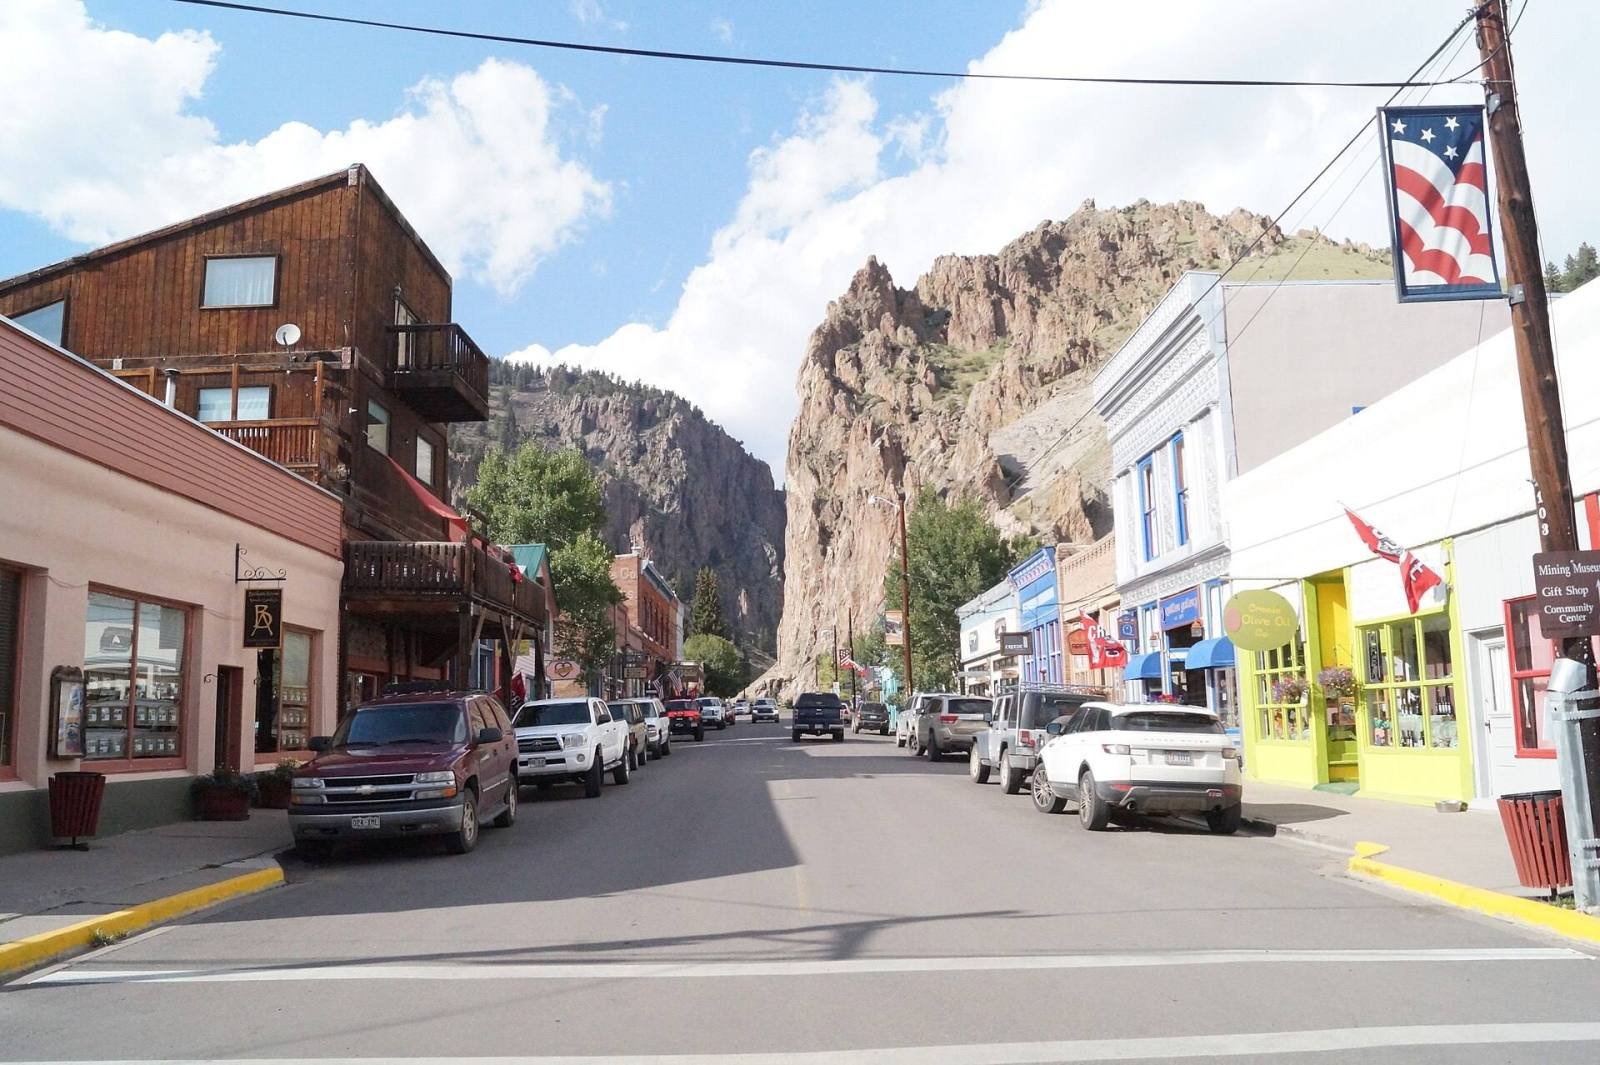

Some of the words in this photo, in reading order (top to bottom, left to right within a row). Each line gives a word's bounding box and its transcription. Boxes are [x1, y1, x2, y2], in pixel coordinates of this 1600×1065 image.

[1538, 563, 1571, 578] Mining
[1572, 562, 1600, 574] Museu
[1541, 586, 1563, 597] Gift
[1565, 585, 1589, 598] Shop
[1543, 602, 1594, 615] Community
[1241, 614, 1271, 626] Olive
[1275, 615, 1291, 627] Oil
[1558, 613, 1587, 624] Center
